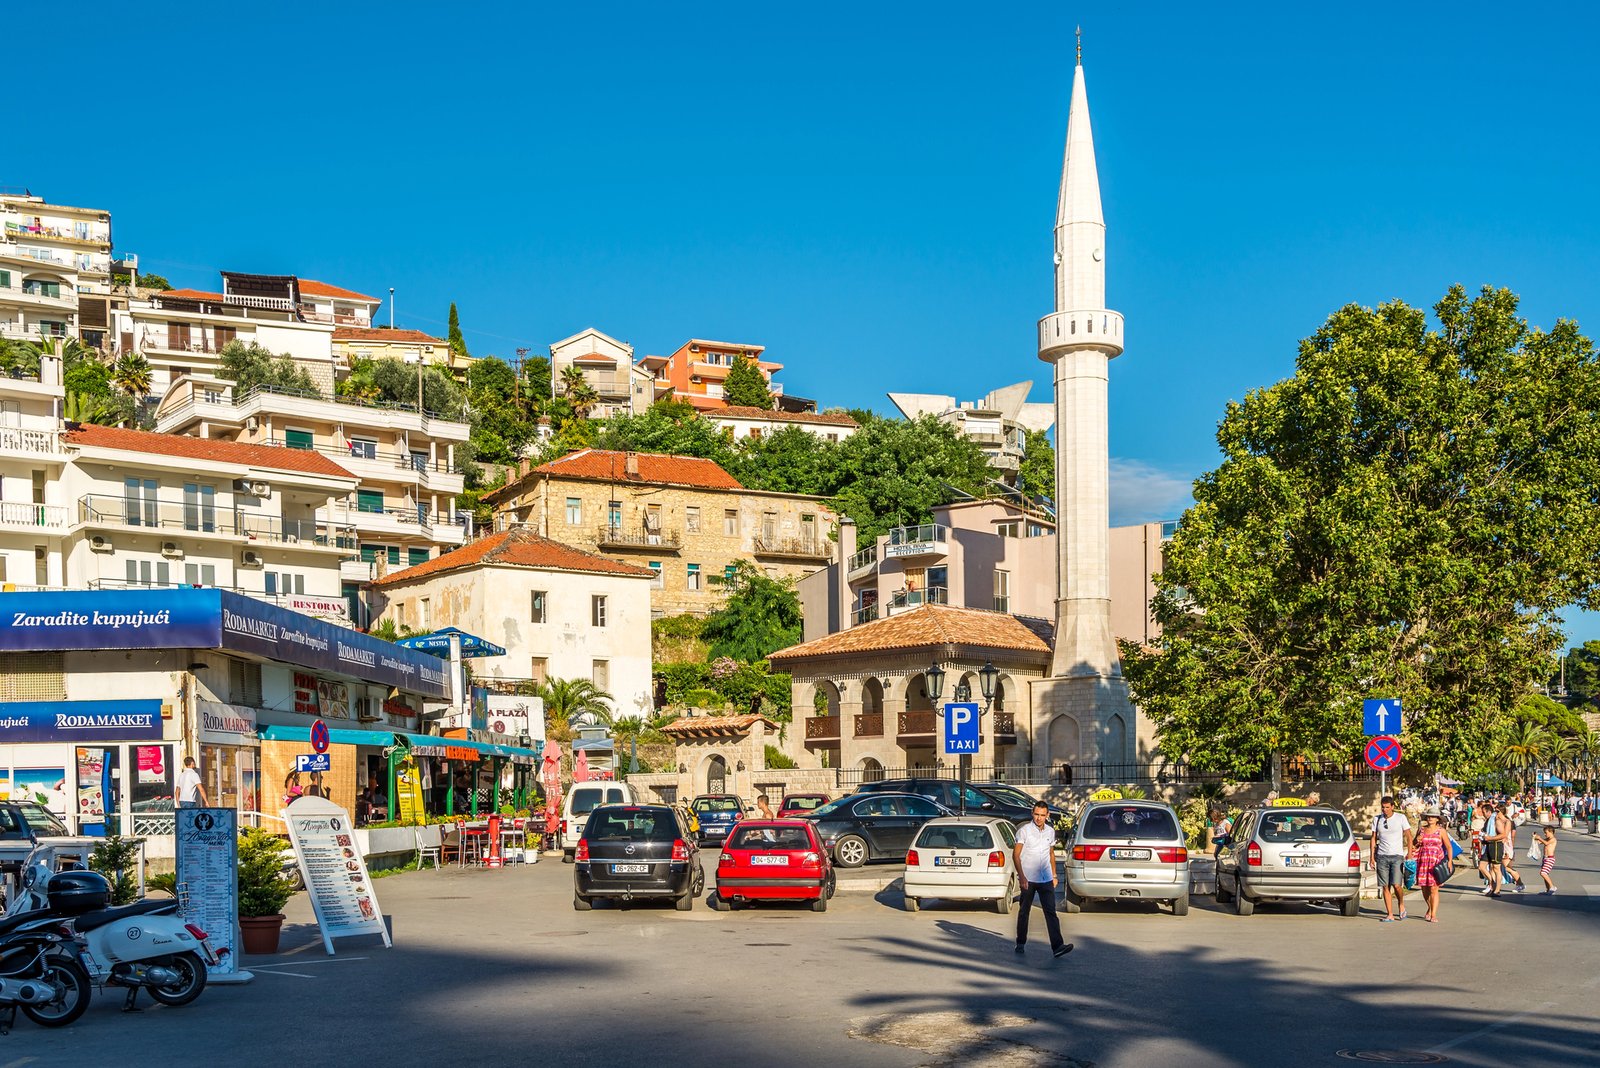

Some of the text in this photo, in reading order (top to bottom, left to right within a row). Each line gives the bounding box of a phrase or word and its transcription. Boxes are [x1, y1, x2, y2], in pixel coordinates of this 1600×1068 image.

[293, 600, 344, 611] RESTORAN
[11, 609, 170, 629] Zaradite kupujući
[280, 626, 305, 645] Zaradite
[496, 709, 527, 718] PLAZA
[952, 707, 971, 735] P
[949, 740, 975, 749] TAXI
[297, 755, 310, 771] P
